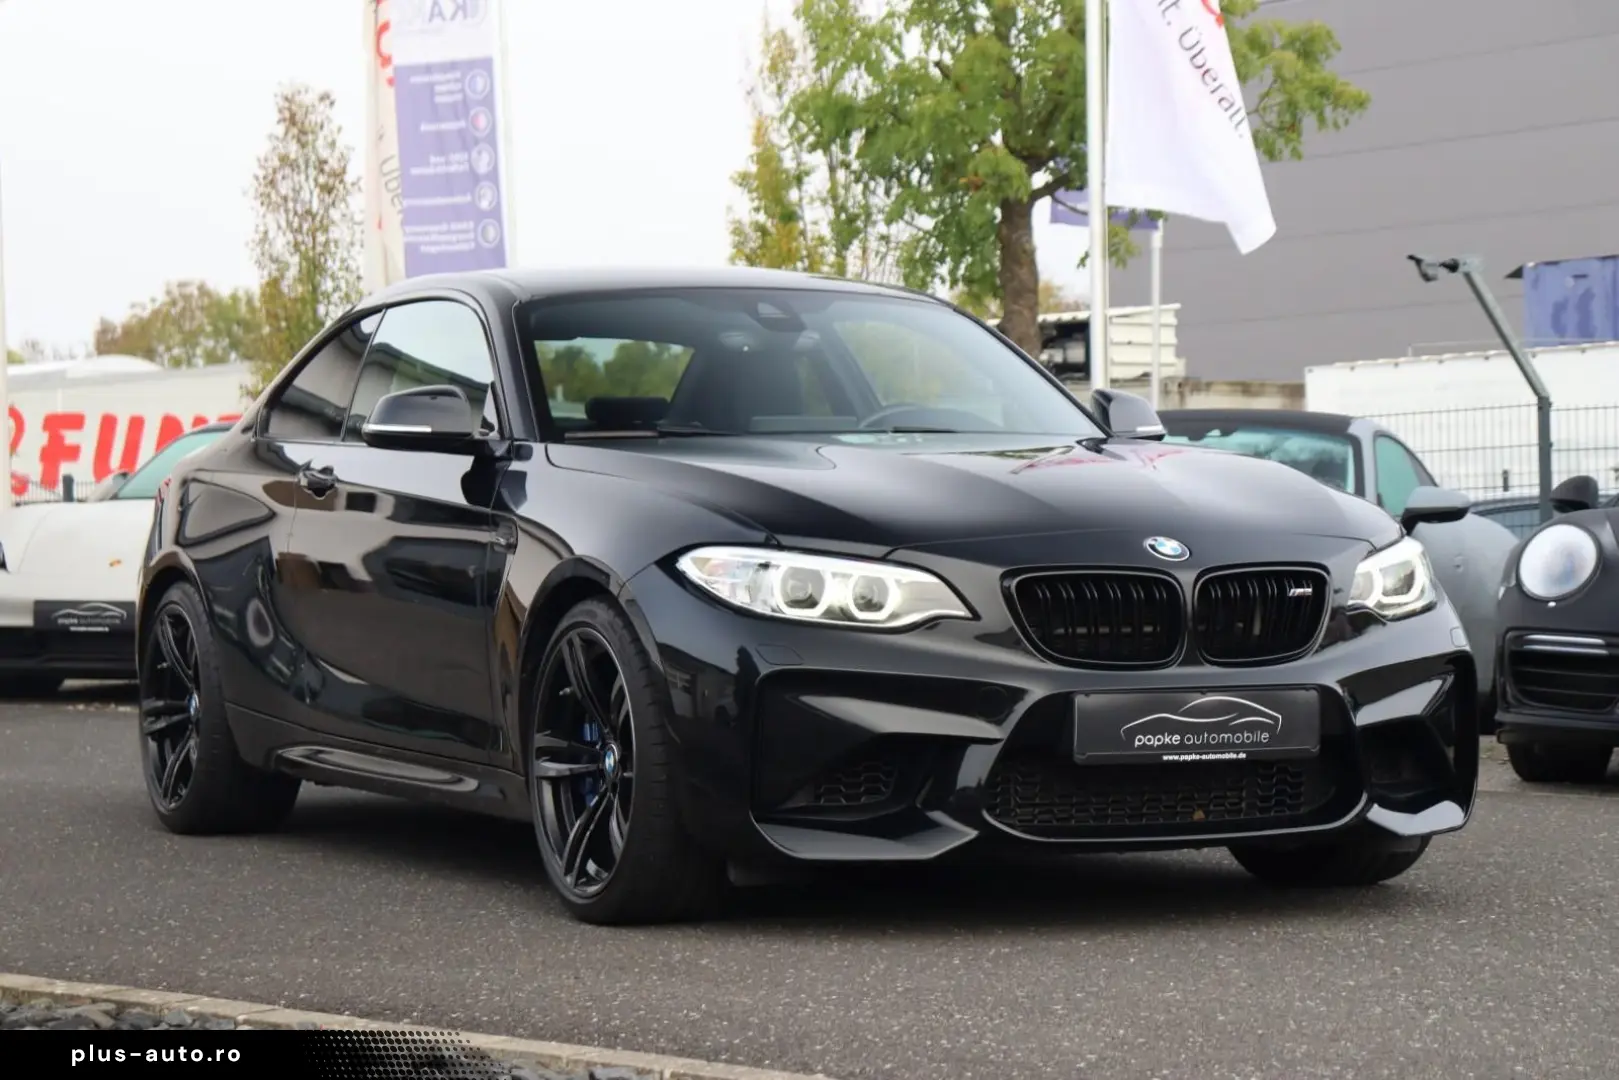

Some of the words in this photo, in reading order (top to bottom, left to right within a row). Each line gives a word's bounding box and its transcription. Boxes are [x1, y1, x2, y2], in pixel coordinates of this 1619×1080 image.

[1178, 26, 1247, 139] Überall.
[1134, 731, 1181, 747] papke
[1184, 729, 1270, 745] automobile
[1162, 751, 1247, 761] www.papke-automobile.de
